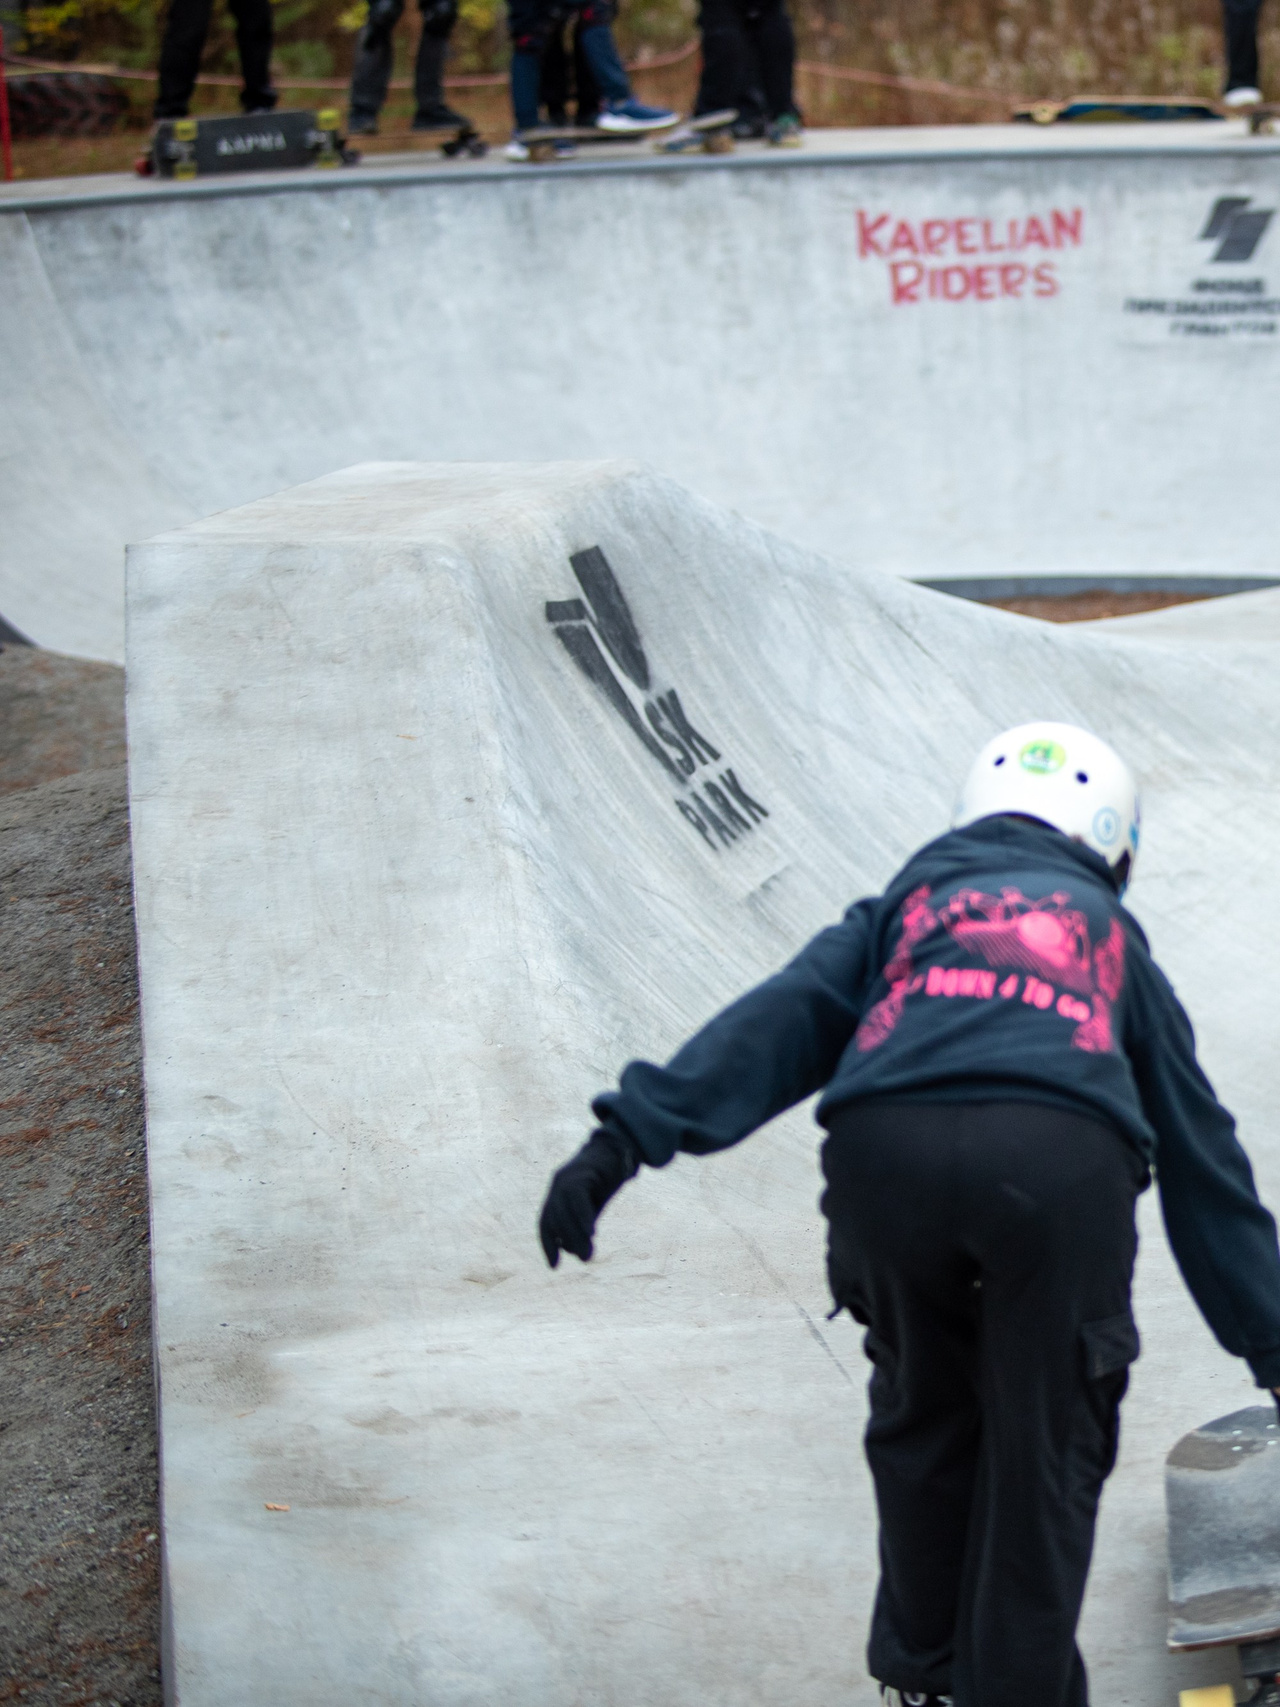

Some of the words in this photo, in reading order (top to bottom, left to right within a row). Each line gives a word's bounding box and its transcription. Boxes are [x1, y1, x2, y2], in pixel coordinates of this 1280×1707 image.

[855, 206, 1083, 259] KARELIAN
[888, 261, 1059, 304] RIDERS
[674, 768, 769, 851] PARK
